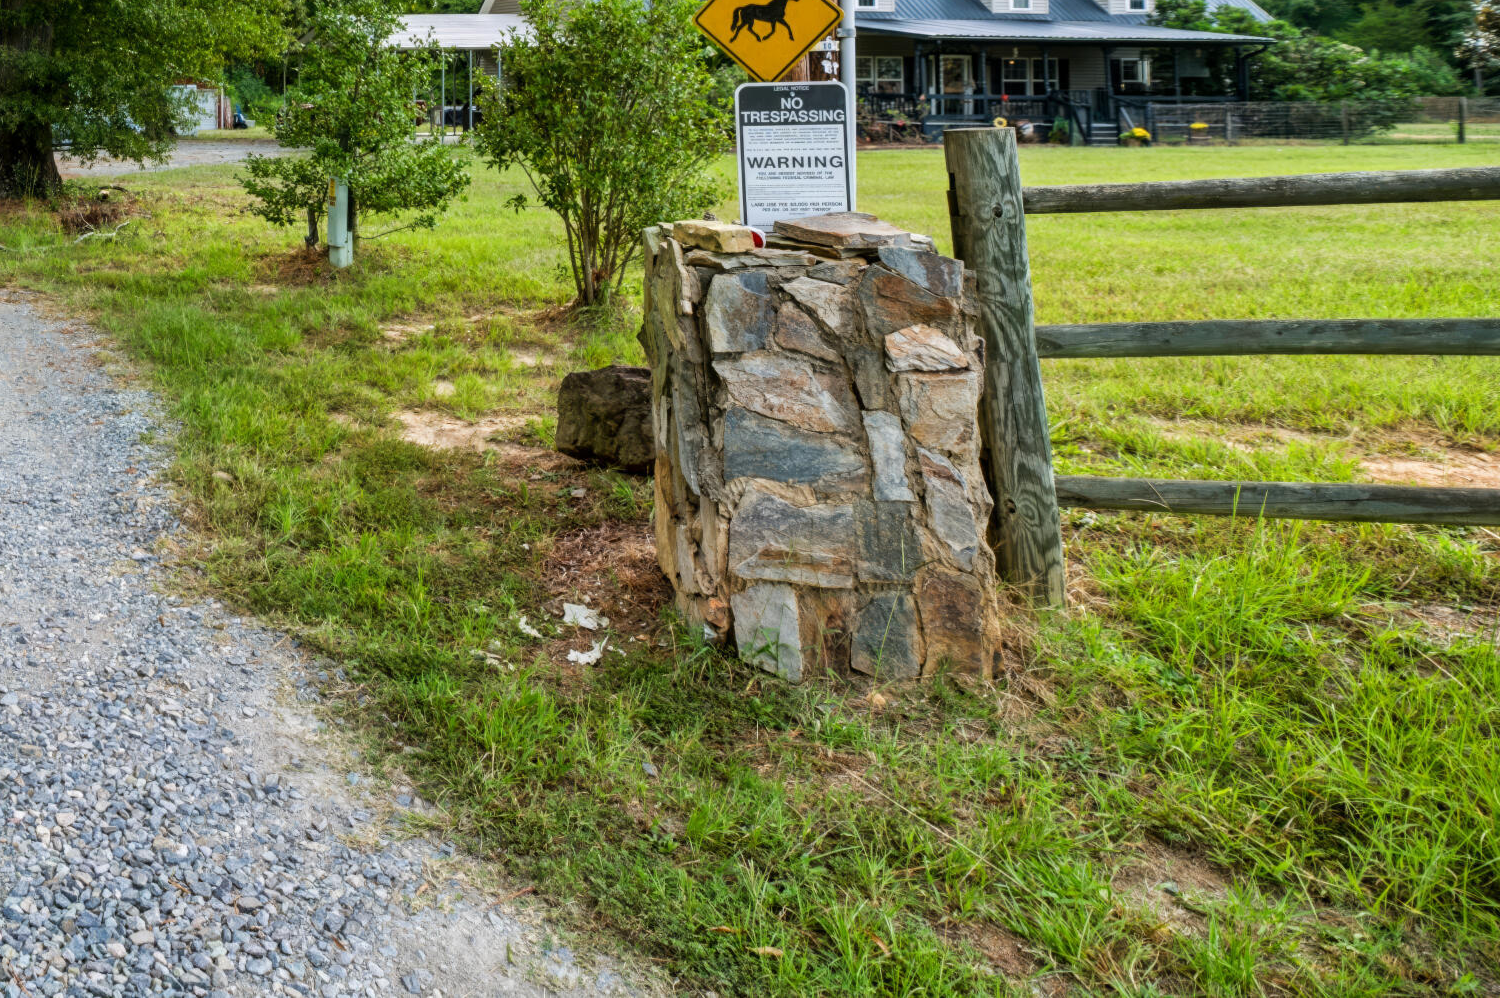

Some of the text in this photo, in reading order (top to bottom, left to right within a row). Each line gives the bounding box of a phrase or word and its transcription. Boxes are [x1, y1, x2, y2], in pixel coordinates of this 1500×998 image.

[780, 97, 803, 110] NO
[741, 109, 845, 123] TRESPASSING
[747, 155, 843, 169] WARNING
